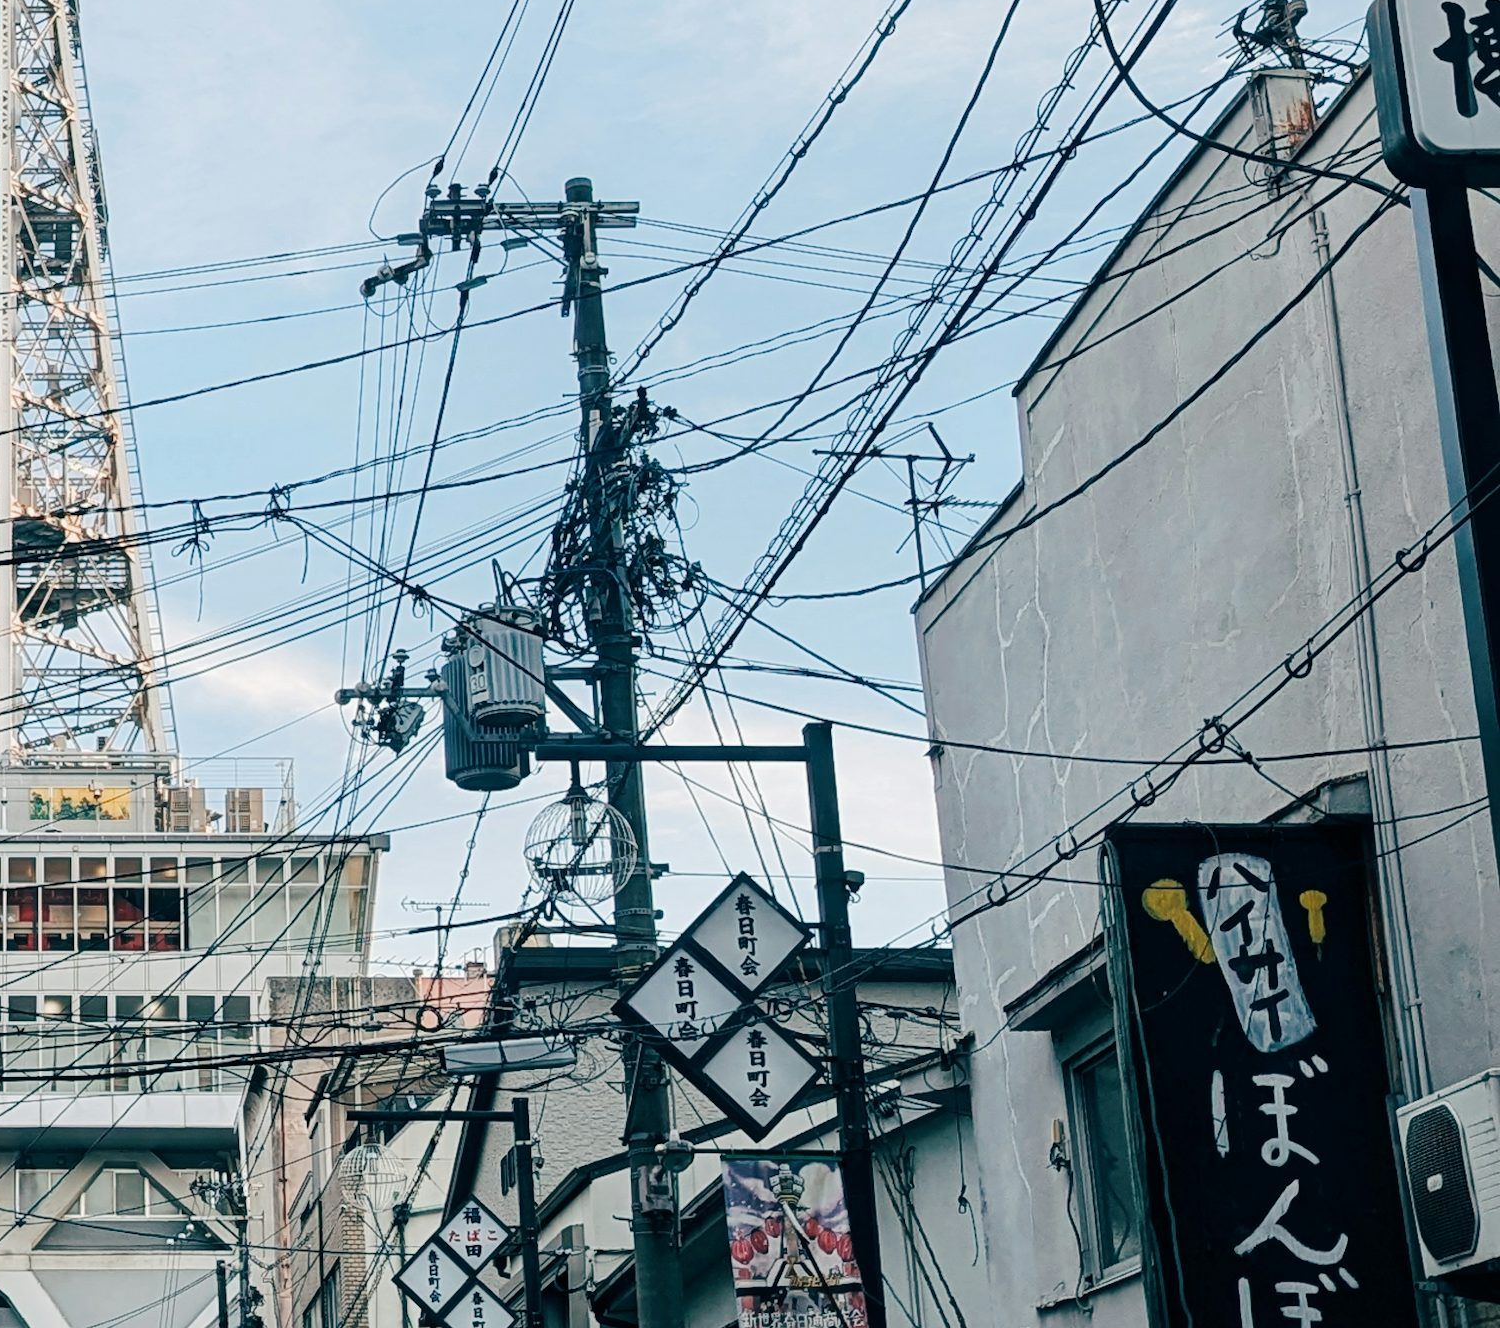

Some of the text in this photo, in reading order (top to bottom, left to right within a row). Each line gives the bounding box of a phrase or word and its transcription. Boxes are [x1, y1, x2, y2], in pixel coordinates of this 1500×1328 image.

[734, 892, 761, 978] 春日町会
[1204, 860, 1284, 1044] ハイサイ
[673, 956, 699, 1042] 春日町会
[745, 1028, 772, 1108] 春日町会
[428, 1249, 442, 1304] 春日町会
[448, 1229, 498, 1243] たばこ
